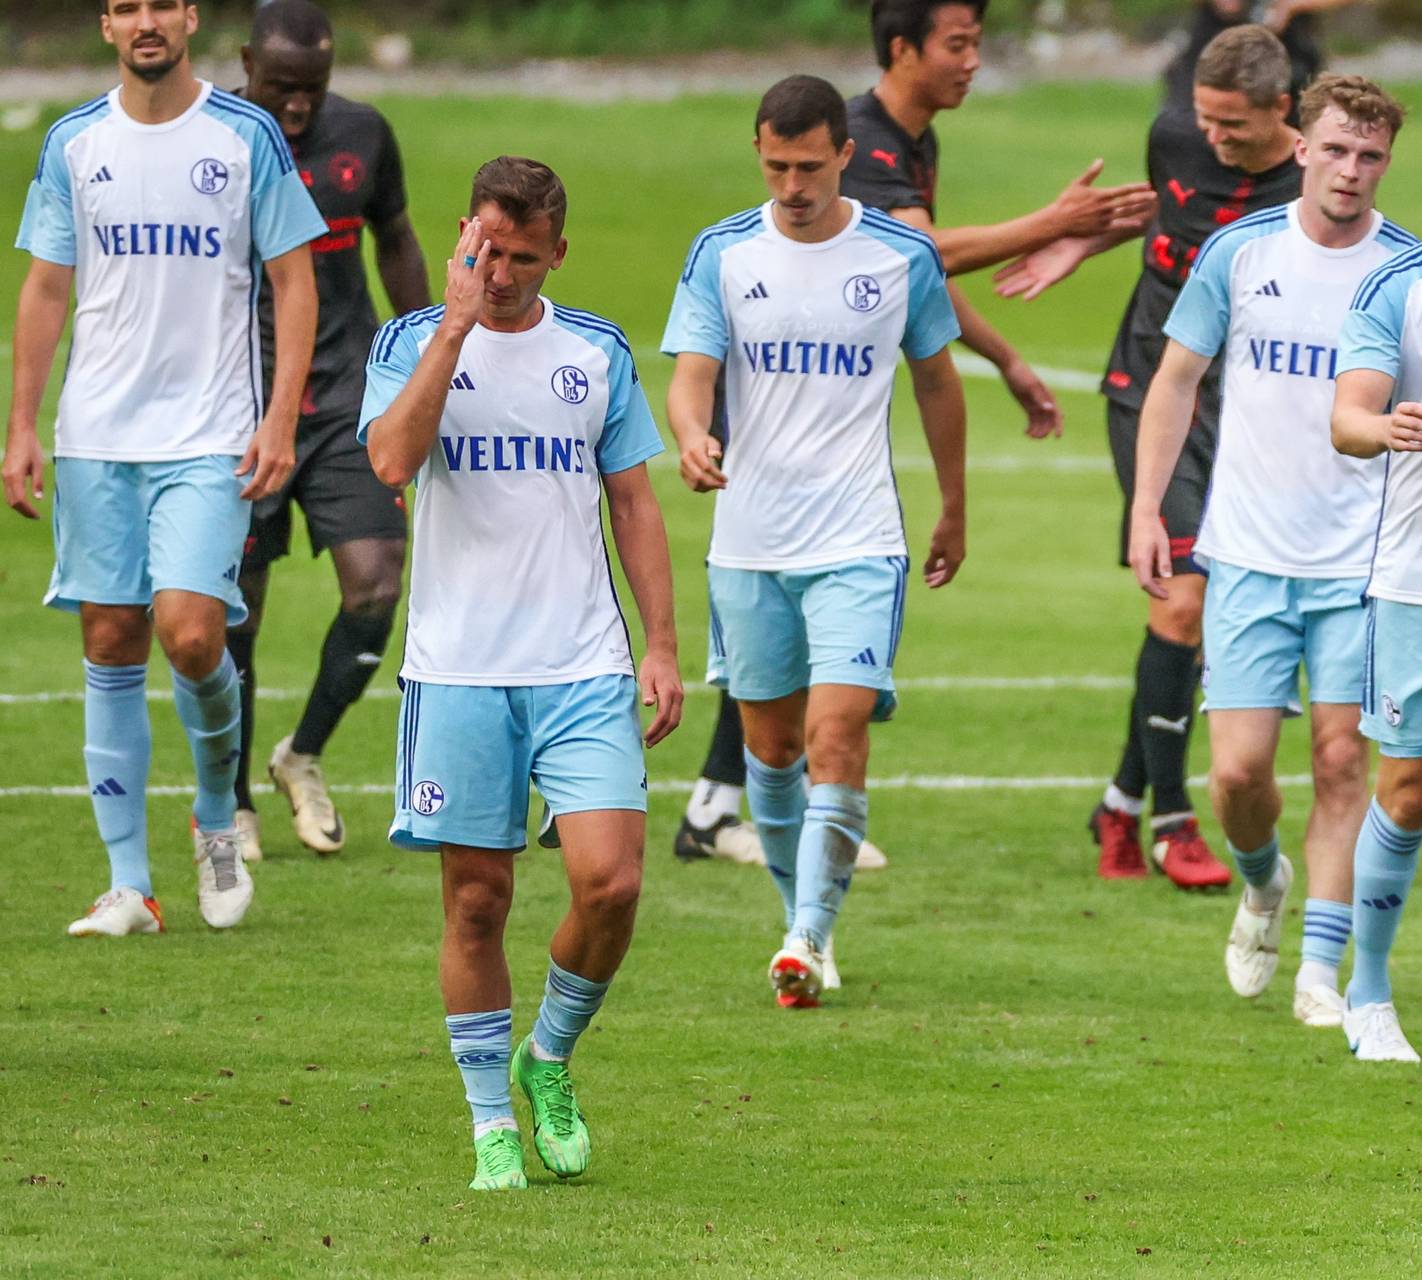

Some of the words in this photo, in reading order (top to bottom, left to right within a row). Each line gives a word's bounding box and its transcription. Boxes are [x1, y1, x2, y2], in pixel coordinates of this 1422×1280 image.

[93, 224, 221, 258] VELTINS
[743, 341, 875, 376] VELTINS
[441, 436, 585, 474] VELTINS
